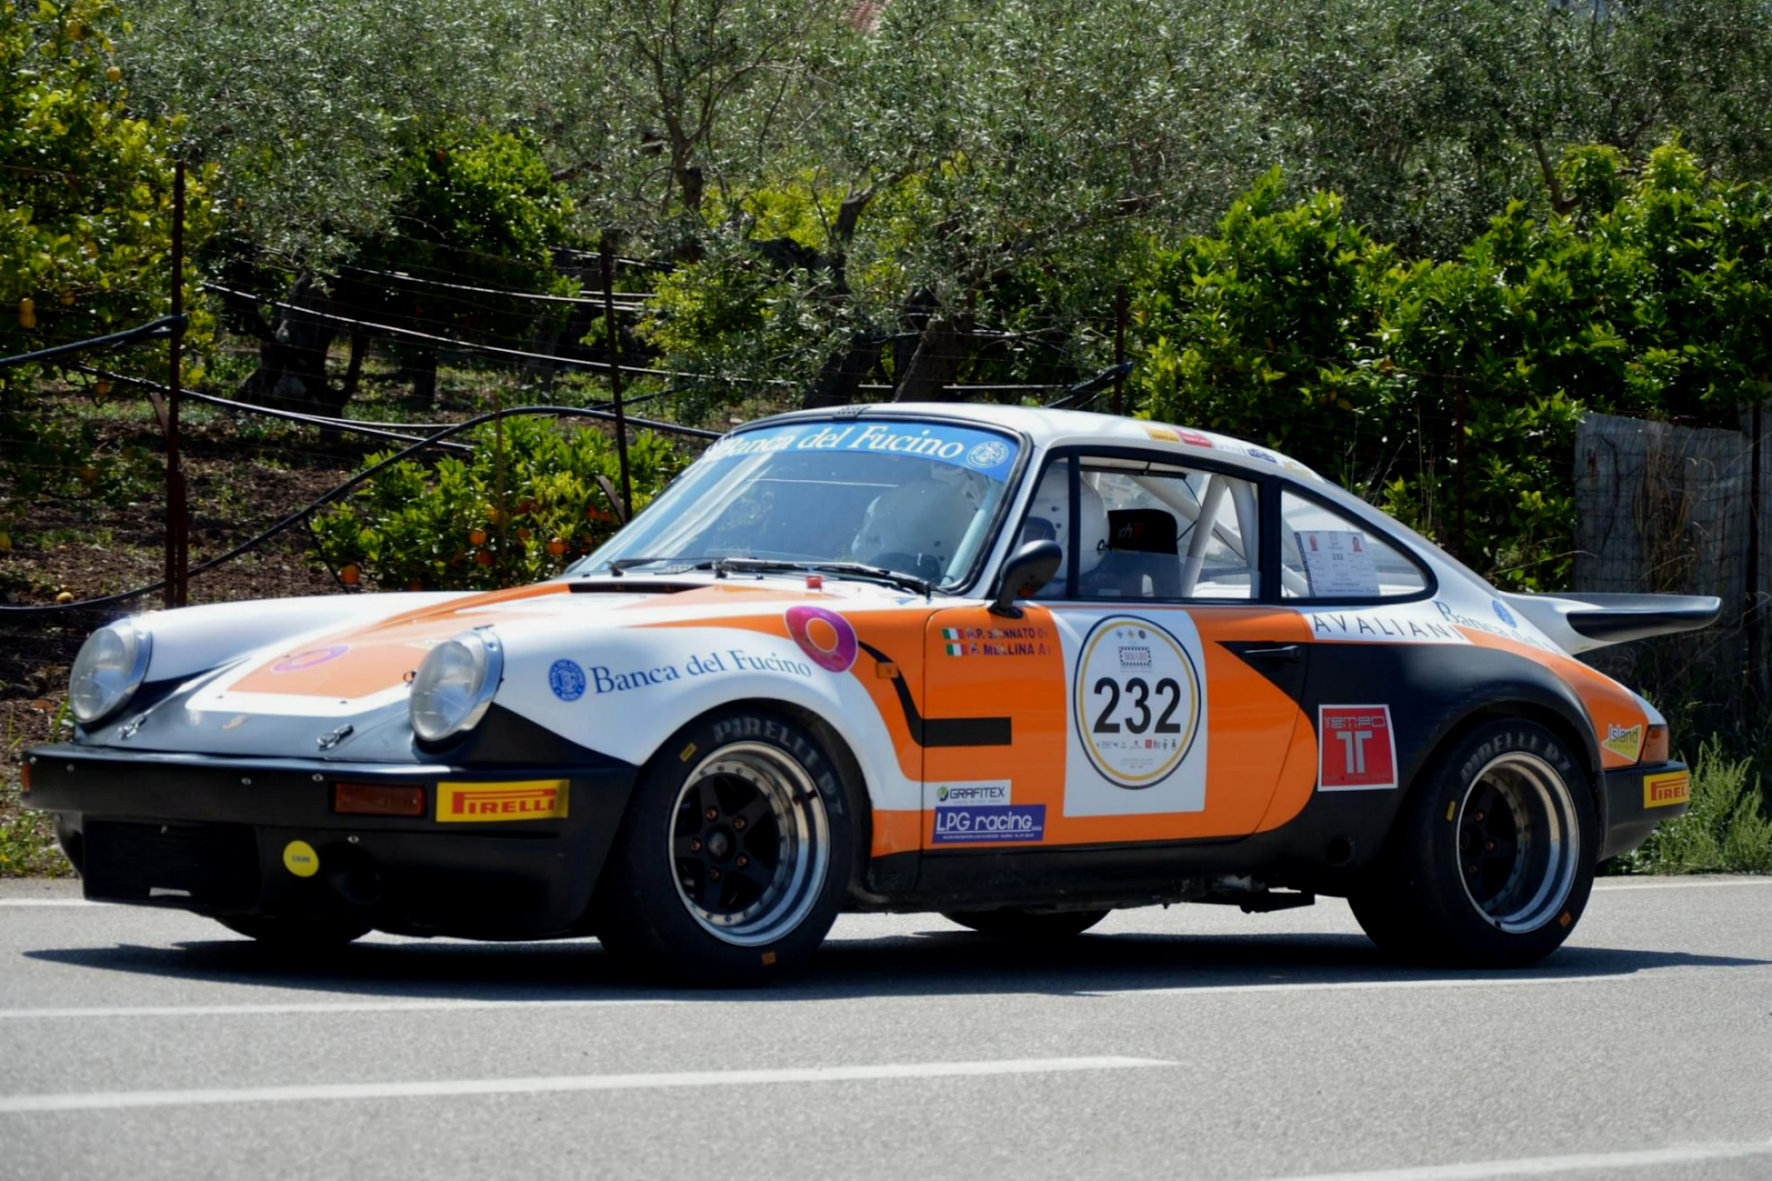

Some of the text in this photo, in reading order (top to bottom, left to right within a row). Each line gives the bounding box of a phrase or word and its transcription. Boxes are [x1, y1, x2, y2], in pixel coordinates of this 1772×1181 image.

[797, 426, 846, 449] del
[852, 425, 963, 459] Fucino
[1314, 614, 1464, 640] AVALIANI
[588, 663, 680, 695] Banca
[687, 652, 725, 675] del
[728, 650, 811, 678] Fucino
[1093, 677, 1181, 734] 232
[1323, 715, 1386, 729] TEMPO
[1608, 723, 1638, 744] Island
[712, 716, 819, 768] PIRELLI
[451, 788, 558, 815] PIRELLI
[950, 787, 1005, 800] GRAFITEX
[936, 812, 971, 832] LPG
